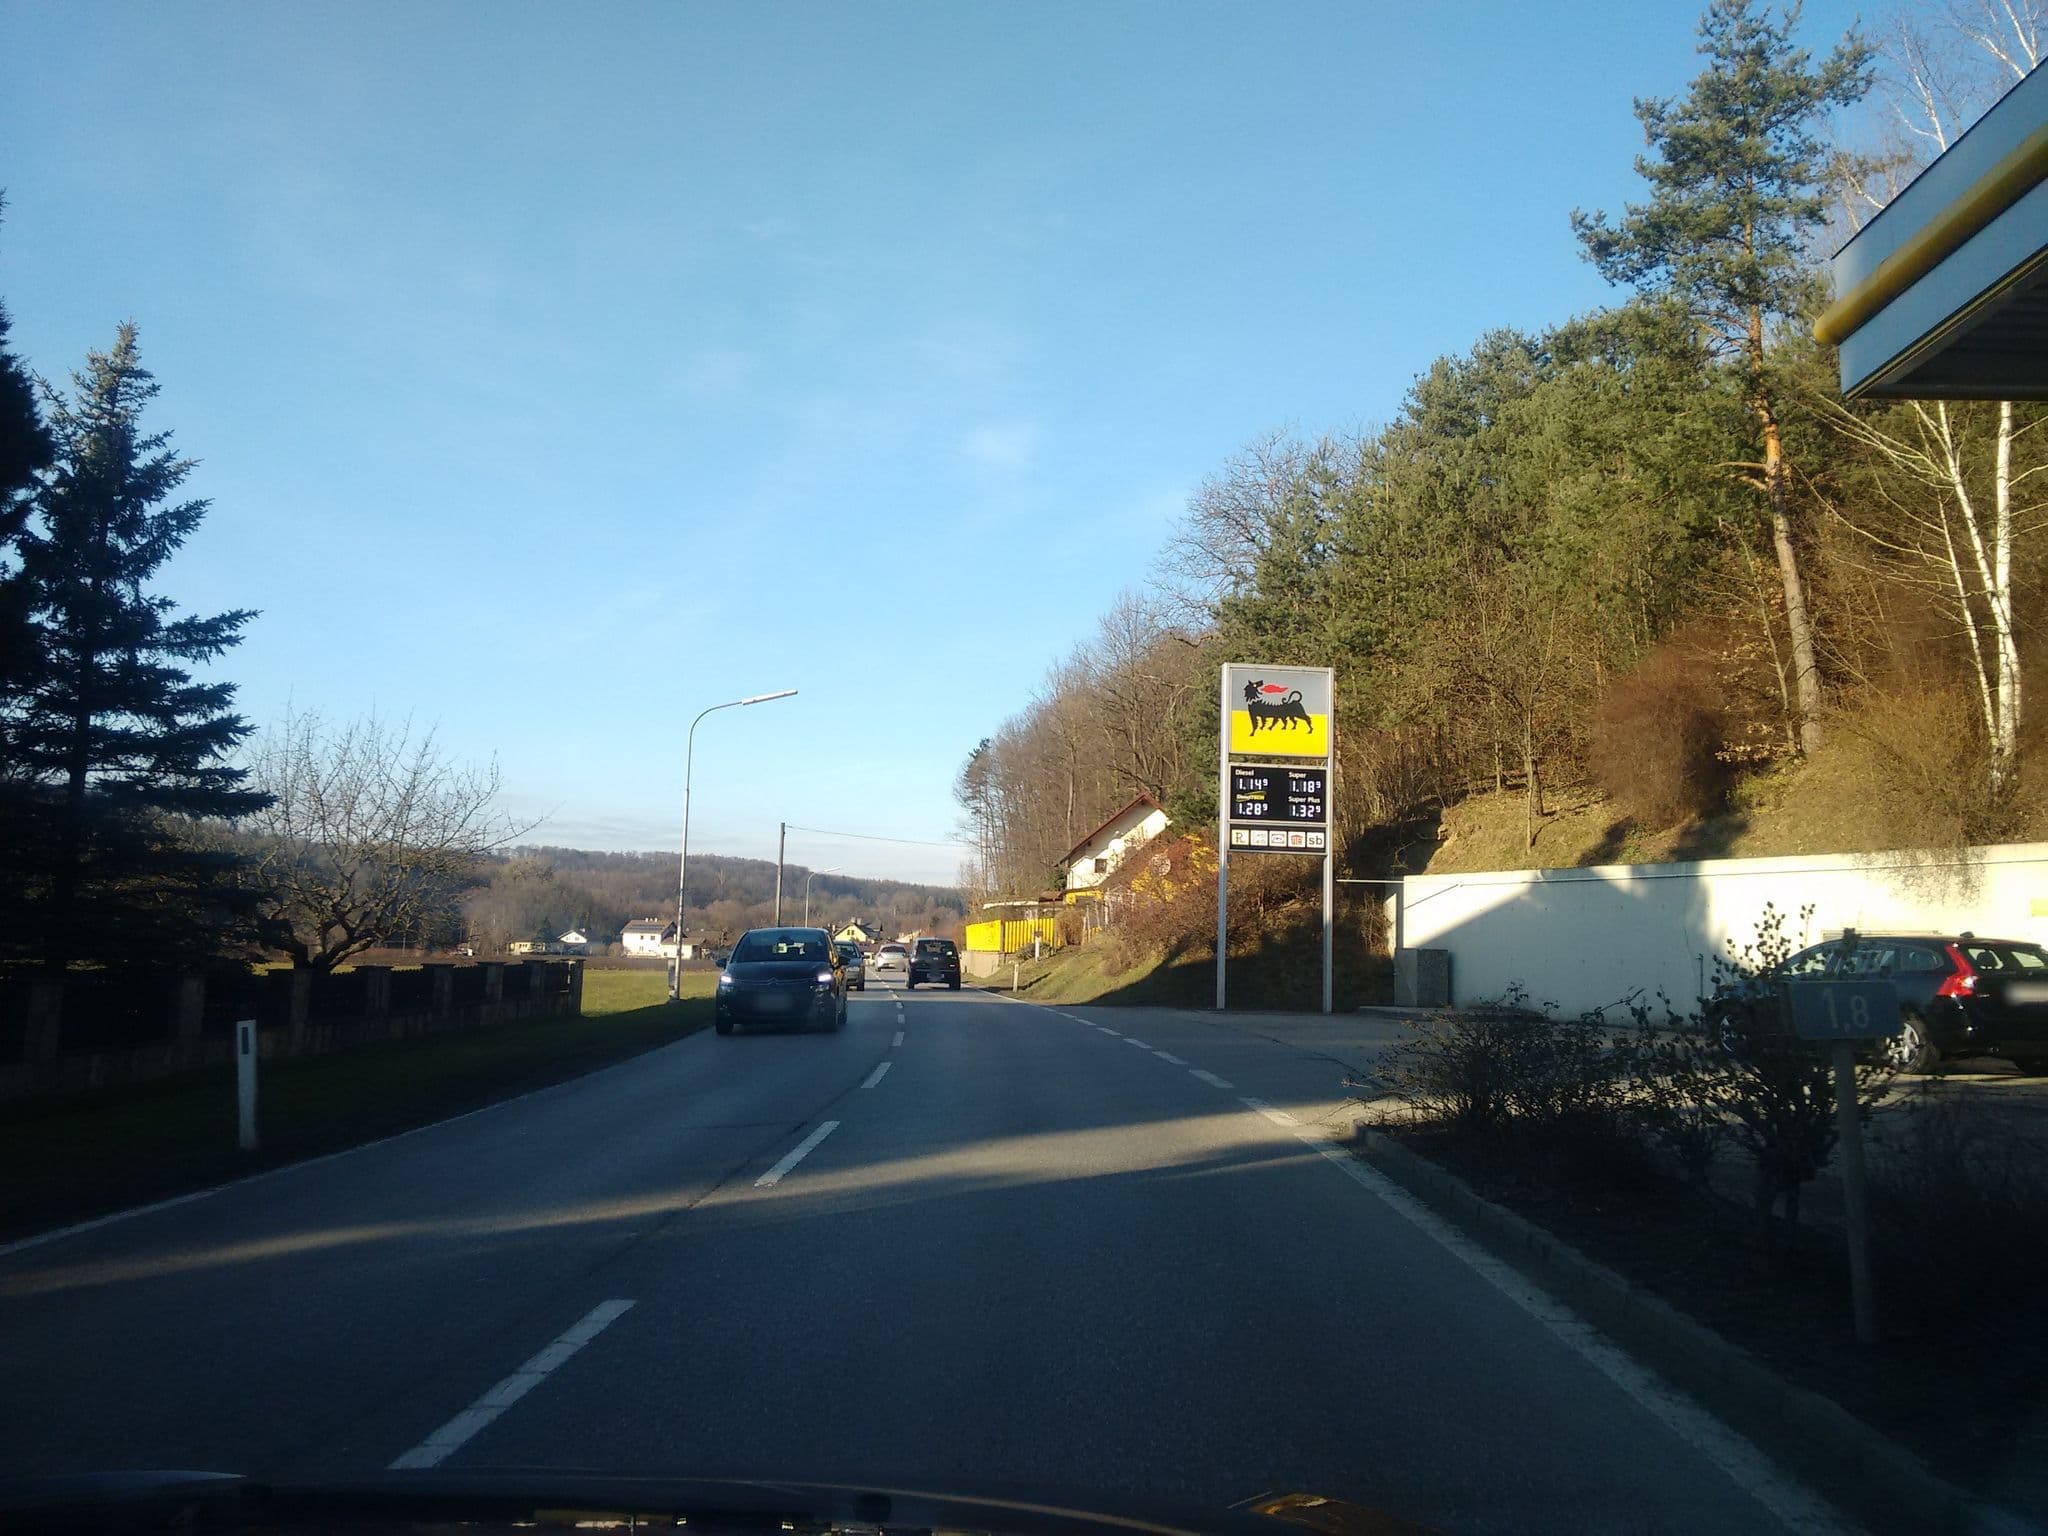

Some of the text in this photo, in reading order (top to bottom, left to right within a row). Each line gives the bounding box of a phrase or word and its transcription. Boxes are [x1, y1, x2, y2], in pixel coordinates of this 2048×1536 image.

[1288, 796, 1321, 804] Super Plus
[1308, 835, 1323, 845] sb
